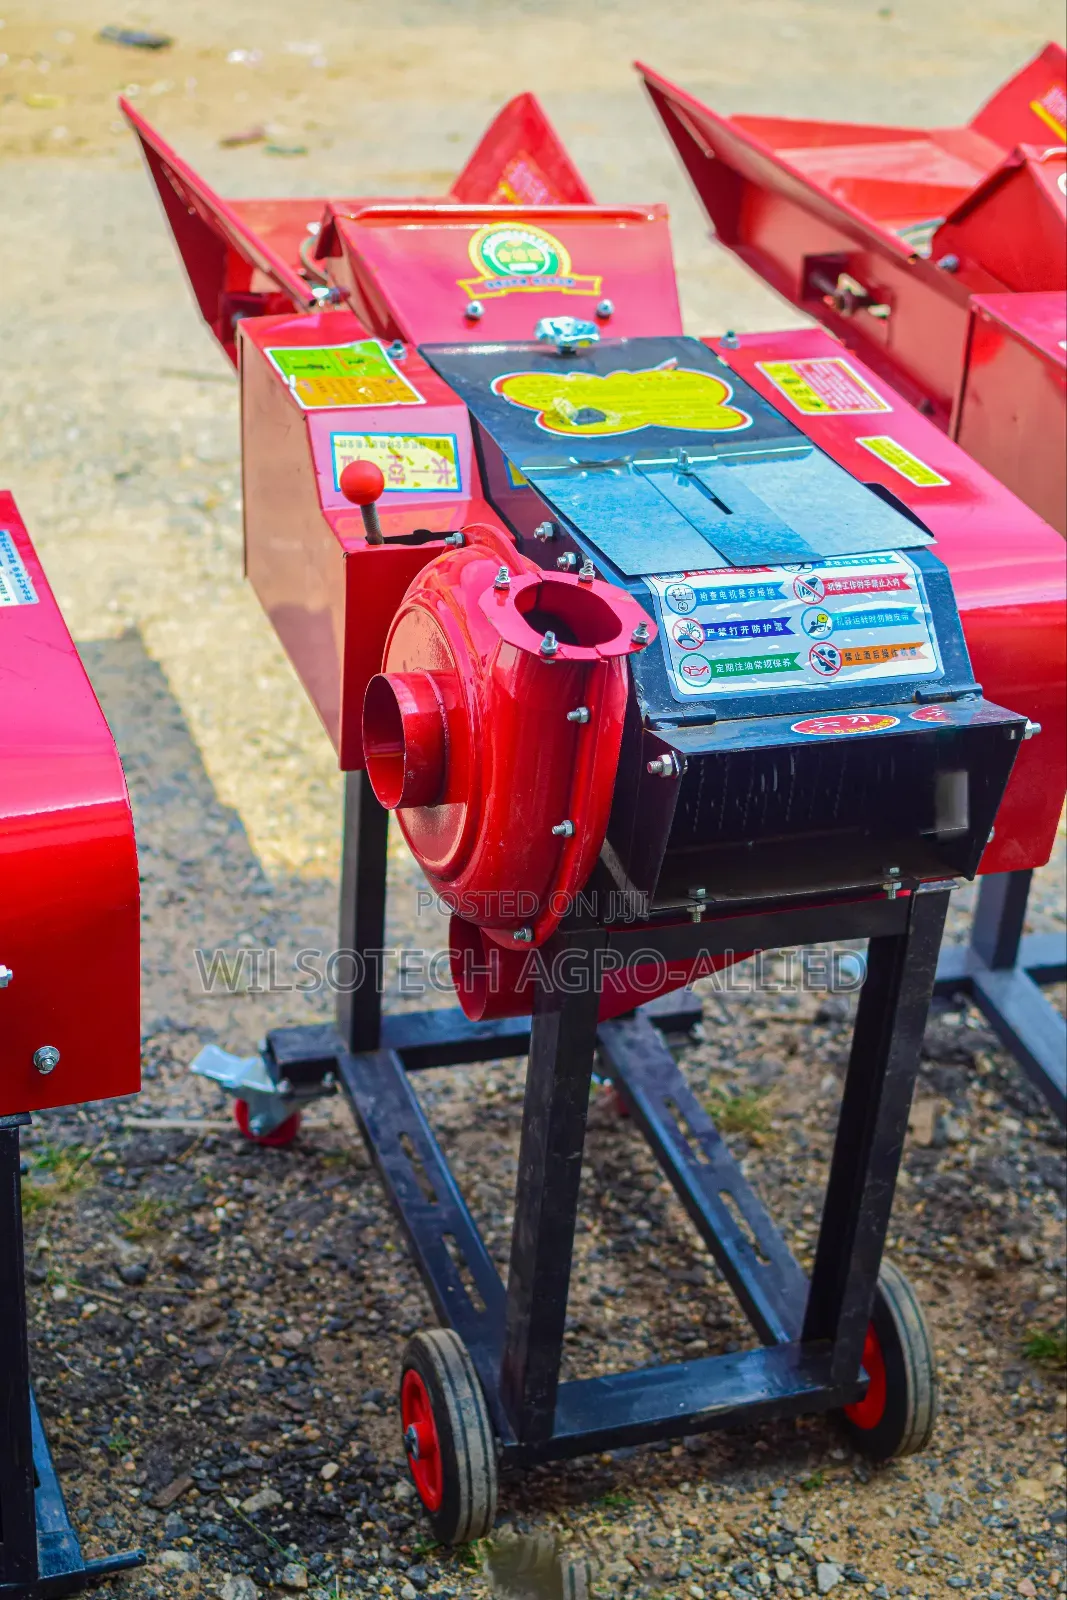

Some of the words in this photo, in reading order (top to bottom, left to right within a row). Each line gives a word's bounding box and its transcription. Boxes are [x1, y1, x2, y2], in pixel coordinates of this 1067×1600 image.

[700, 586, 776, 602] 检查电机是否接地
[836, 612, 909, 626] 机器运转时勿触皮带
[706, 620, 784, 637] 严禁打开防护罩
[844, 646, 917, 661] 禁止酒后操作机器
[715, 658, 792, 673] 定期注油常规保养
